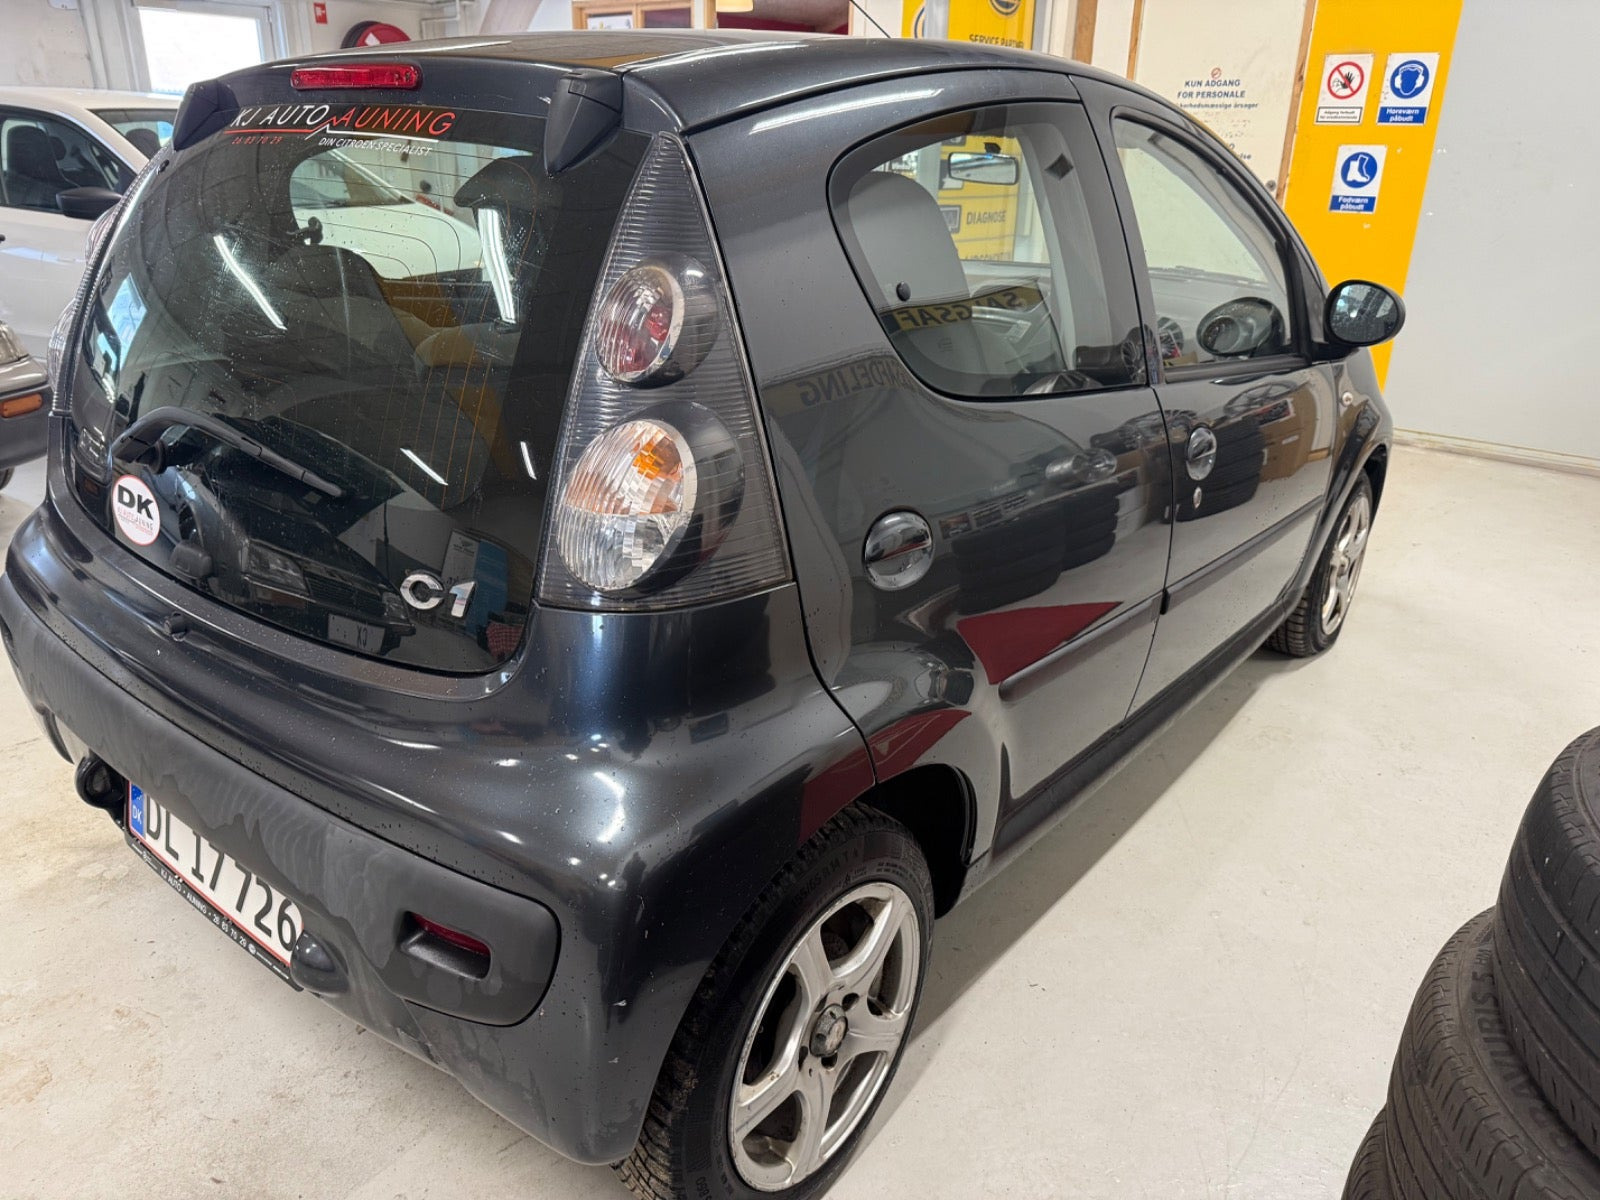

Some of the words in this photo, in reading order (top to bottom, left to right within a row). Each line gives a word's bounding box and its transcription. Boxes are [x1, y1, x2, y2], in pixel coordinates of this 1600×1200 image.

[969, 33, 999, 45] SERVICE
[1196, 90, 1246, 98] PERSONALE
[1205, 79, 1241, 87] ADGANG
[230, 107, 262, 127] KJ
[259, 104, 330, 126] AUTO
[333, 106, 456, 136] AUNING
[318, 137, 334, 146] DIN
[966, 210, 1007, 226] DIAGNOSE
[117, 483, 154, 521] DK
[400, 573, 476, 618] C1
[131, 804, 143, 826] DK
[146, 795, 179, 862] DL
[167, 875, 182, 893] AUTO
[186, 892, 207, 915] AUNING
